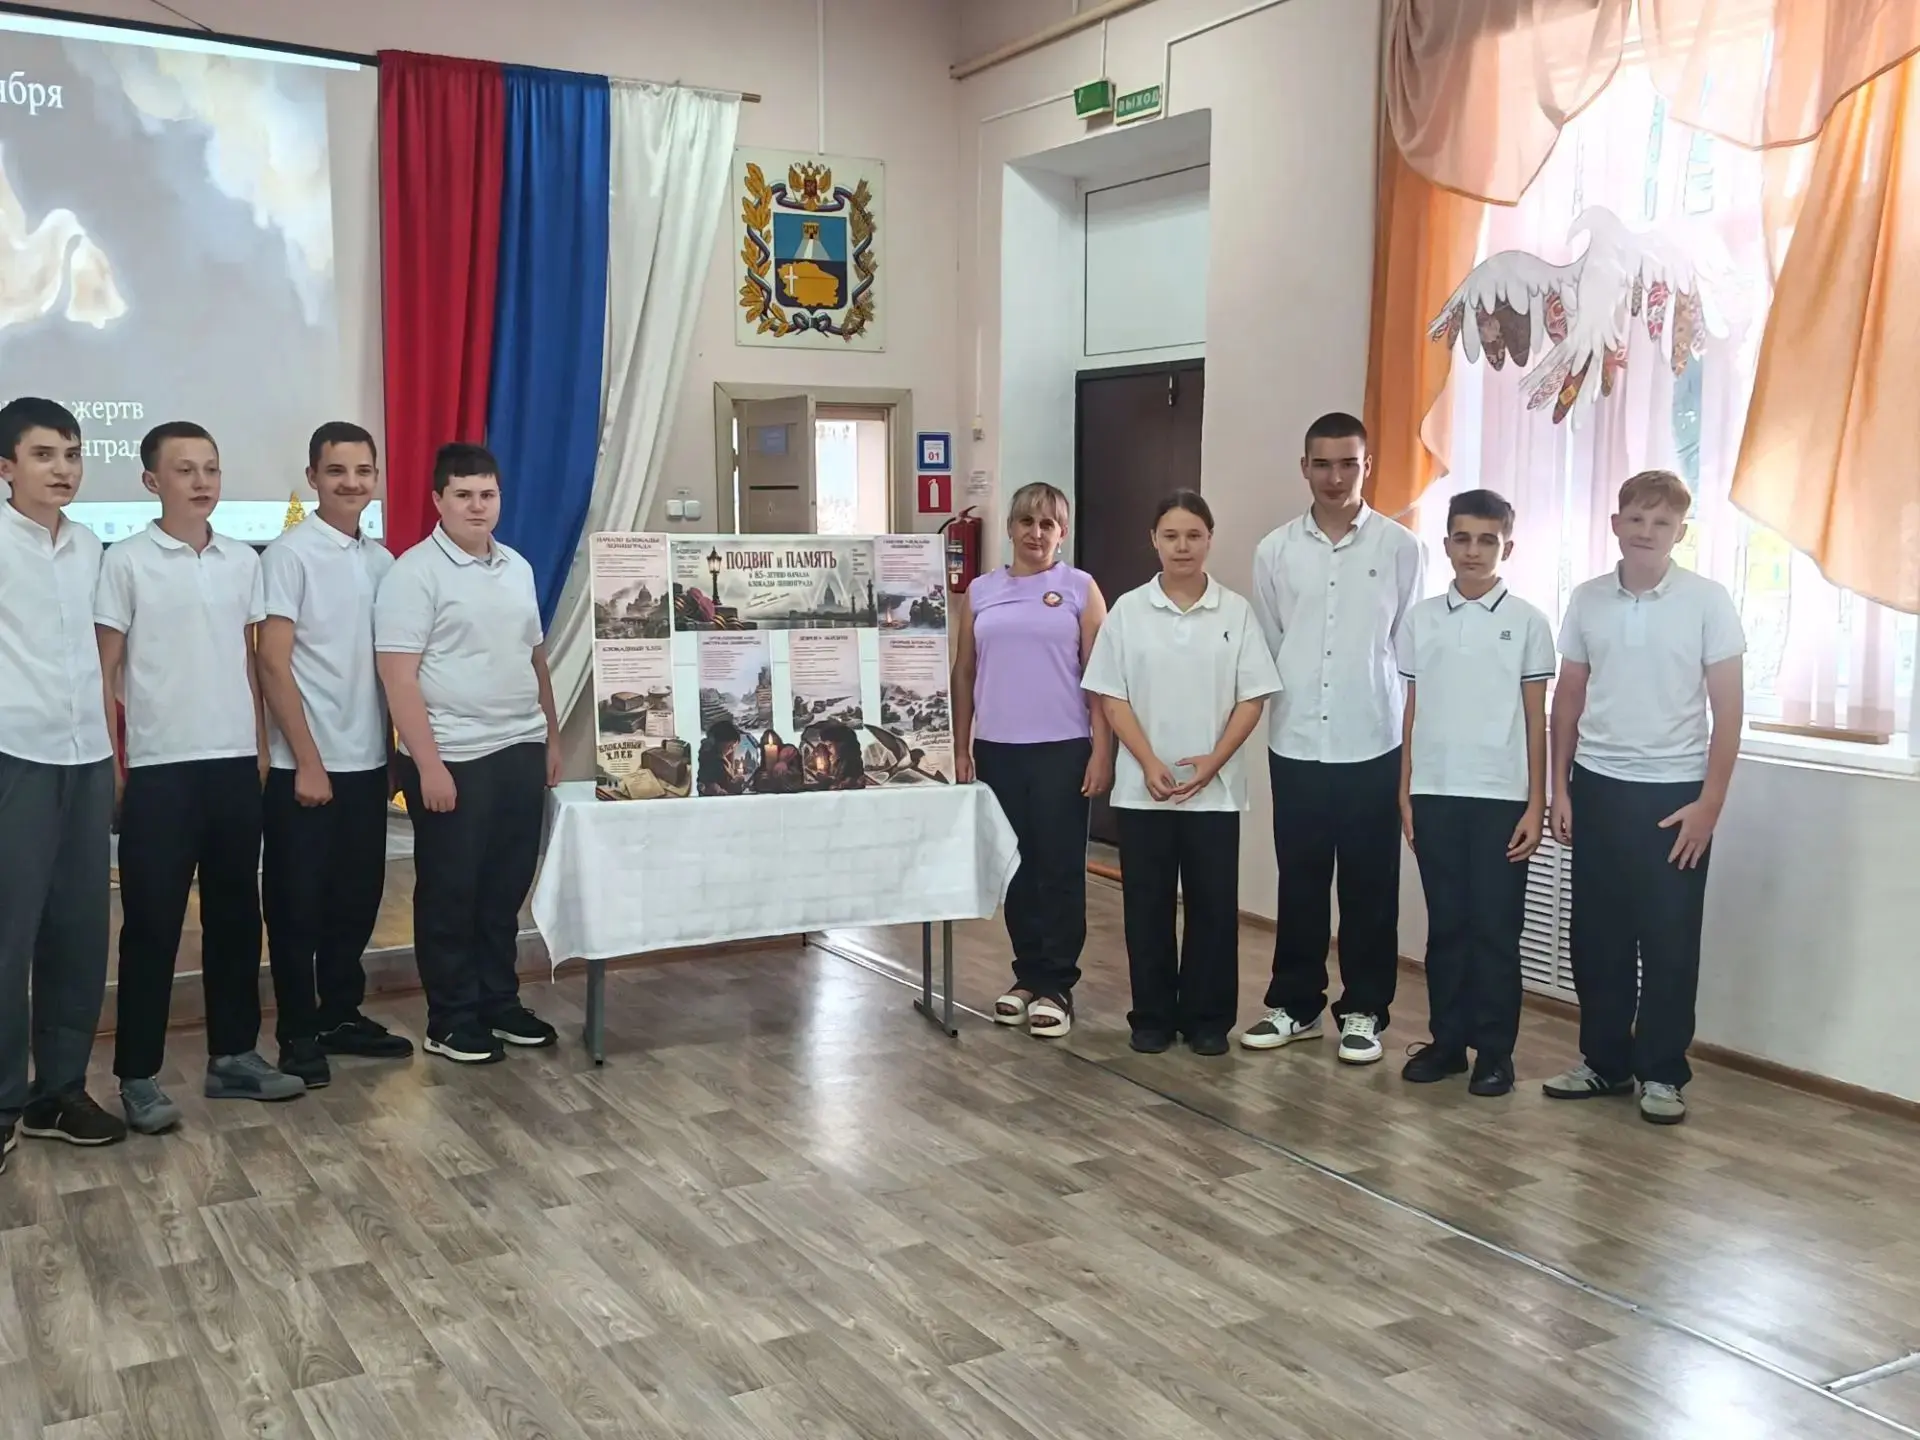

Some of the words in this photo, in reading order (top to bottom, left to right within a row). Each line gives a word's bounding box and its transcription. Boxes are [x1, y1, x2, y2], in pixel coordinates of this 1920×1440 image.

[1118, 88, 1159, 113] ВЫХОД
[72, 400, 144, 426] жертв
[928, 451, 940, 461] 01
[726, 551, 774, 571] ПОДВИГ
[786, 550, 837, 569] ПАМЯТЬ
[606, 750, 633, 760] ХЛЕБ
